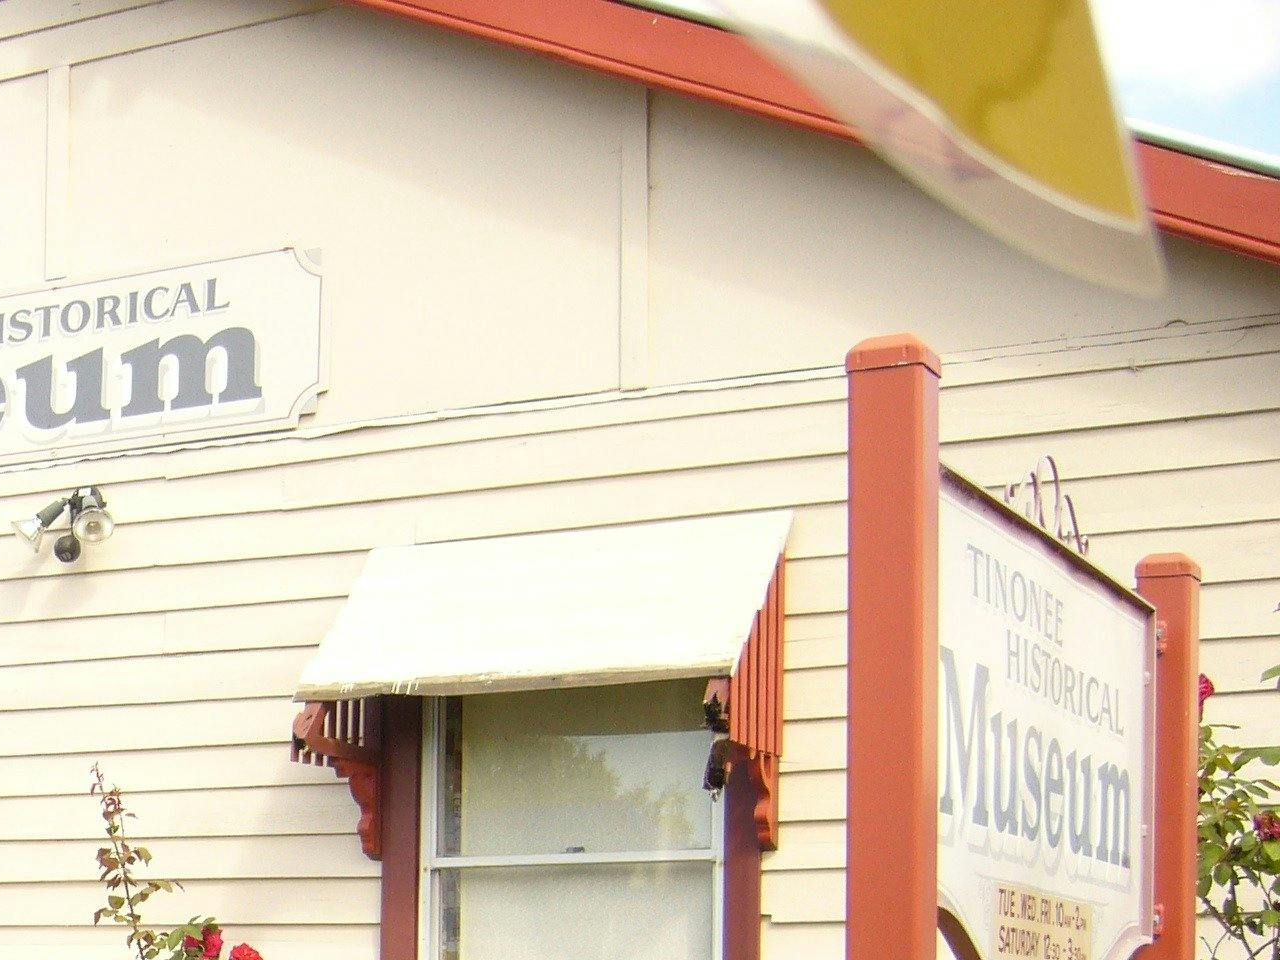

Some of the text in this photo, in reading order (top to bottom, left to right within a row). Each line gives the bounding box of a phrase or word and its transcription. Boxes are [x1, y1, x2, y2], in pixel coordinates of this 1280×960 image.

[966, 543, 1064, 648] TINONEE
[1006, 629, 1124, 736] HISTORICAL
[939, 645, 1131, 869] Museum
[998, 925, 1041, 958] SATURDAY
